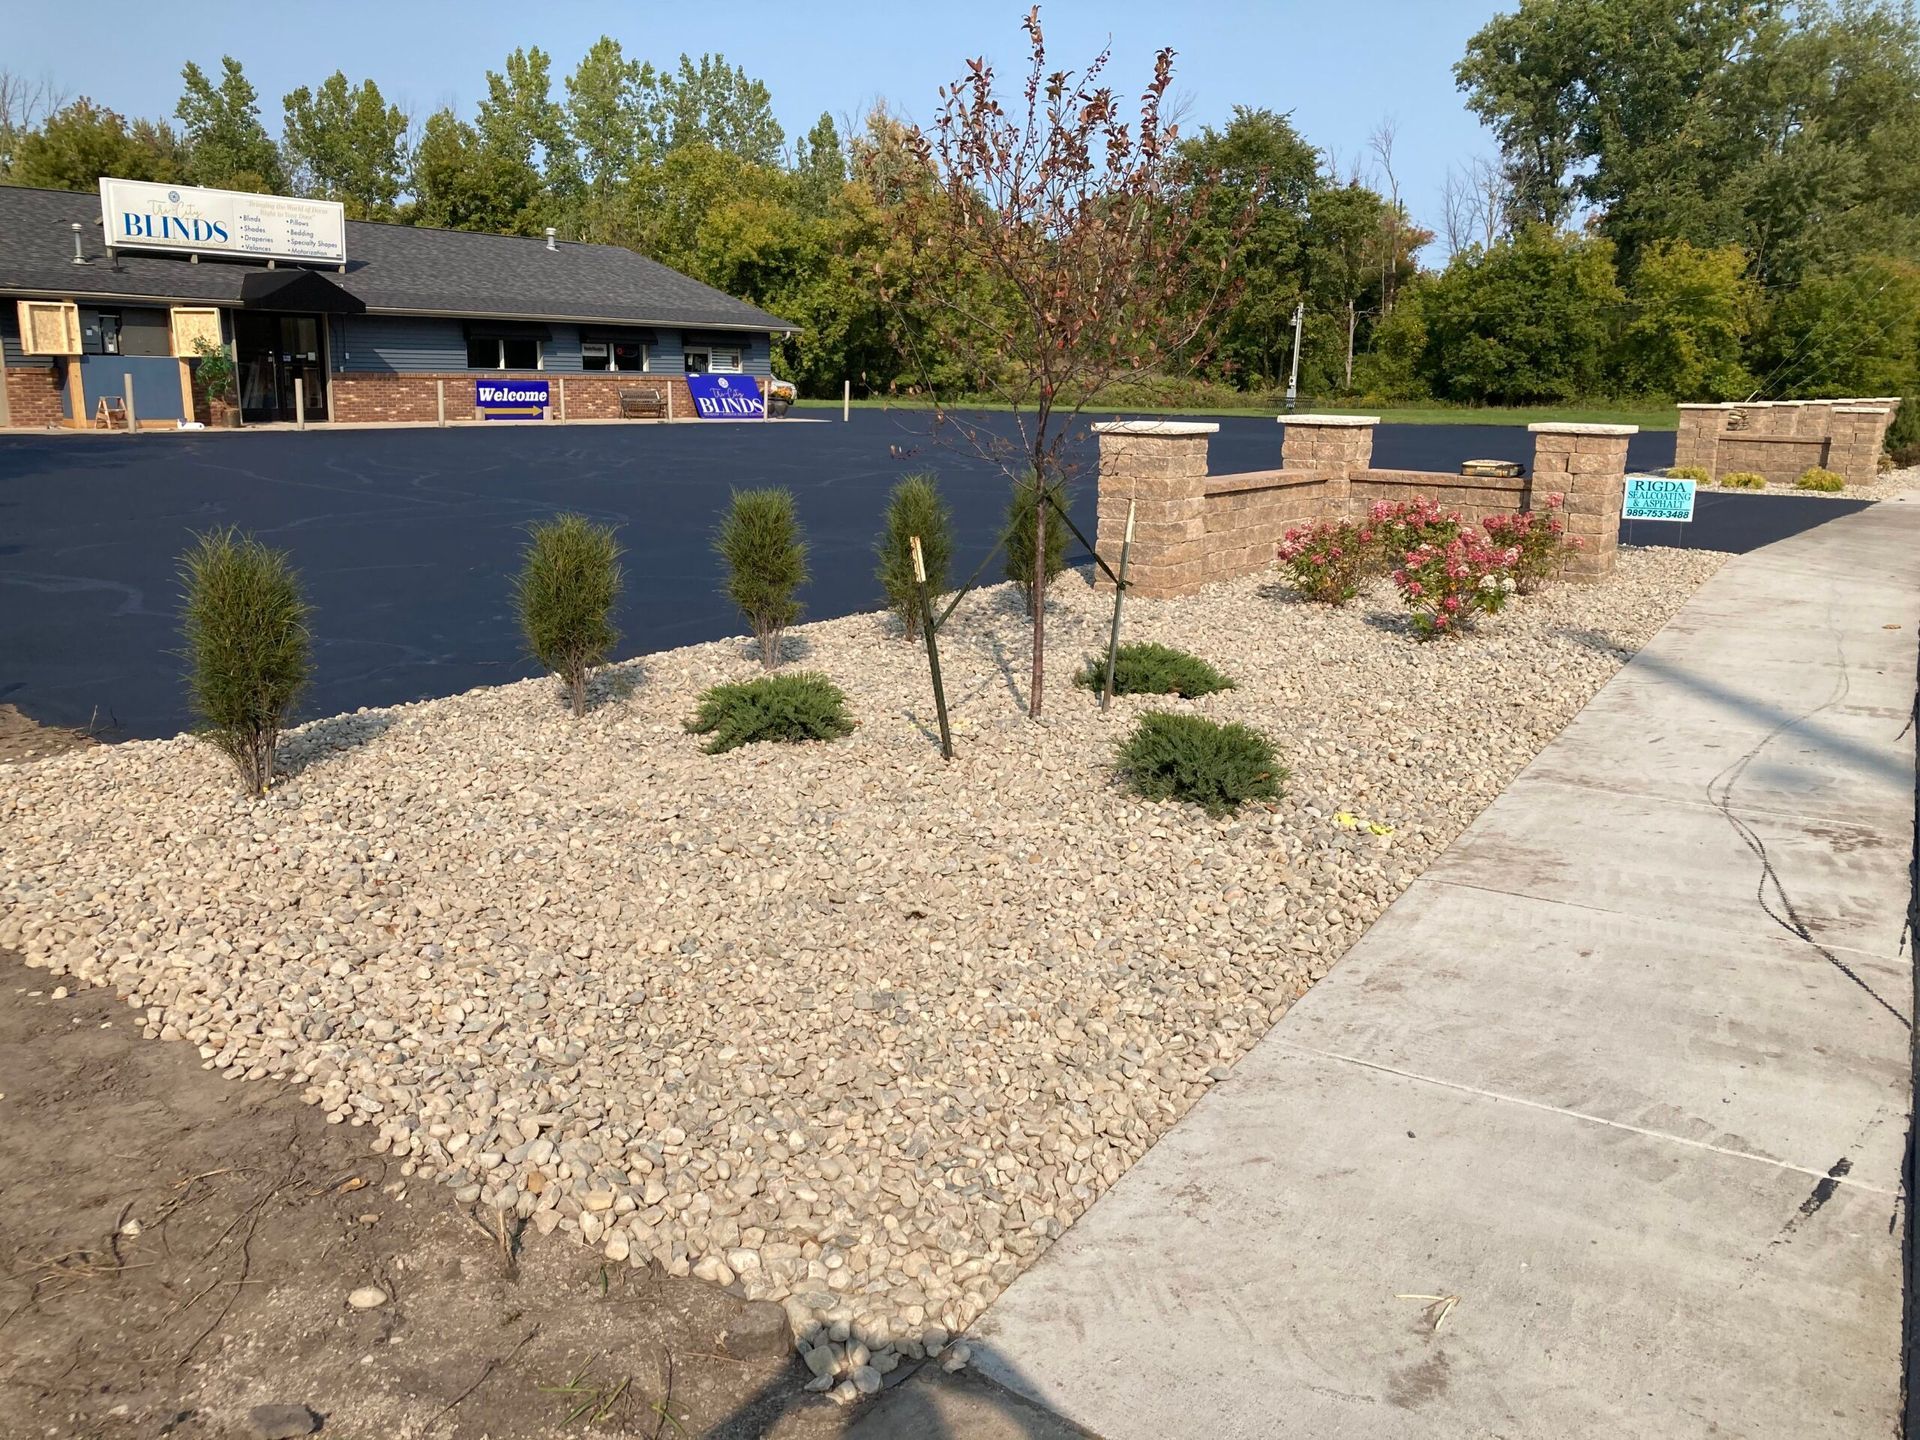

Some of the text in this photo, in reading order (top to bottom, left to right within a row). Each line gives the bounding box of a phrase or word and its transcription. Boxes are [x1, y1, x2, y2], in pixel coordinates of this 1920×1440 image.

[260, 208, 276, 216] Right
[122, 212, 229, 243] BLINDS
[244, 225, 266, 233] Shades
[290, 229, 314, 238] Bedding
[244, 235, 273, 244] Draperies
[291, 239, 337, 249] Specialty Shapes
[245, 244, 271, 252] Valances
[291, 248, 327, 256] Motorization
[478, 388, 548, 402] Welcome
[697, 397, 764, 413] BLINDS
[1635, 481, 1686, 492] RIGDA
[1628, 491, 1691, 501] SEALCOATING
[1633, 499, 1684, 509] & ASPHALT
[1626, 509, 1690, 519] 989-753-3488
